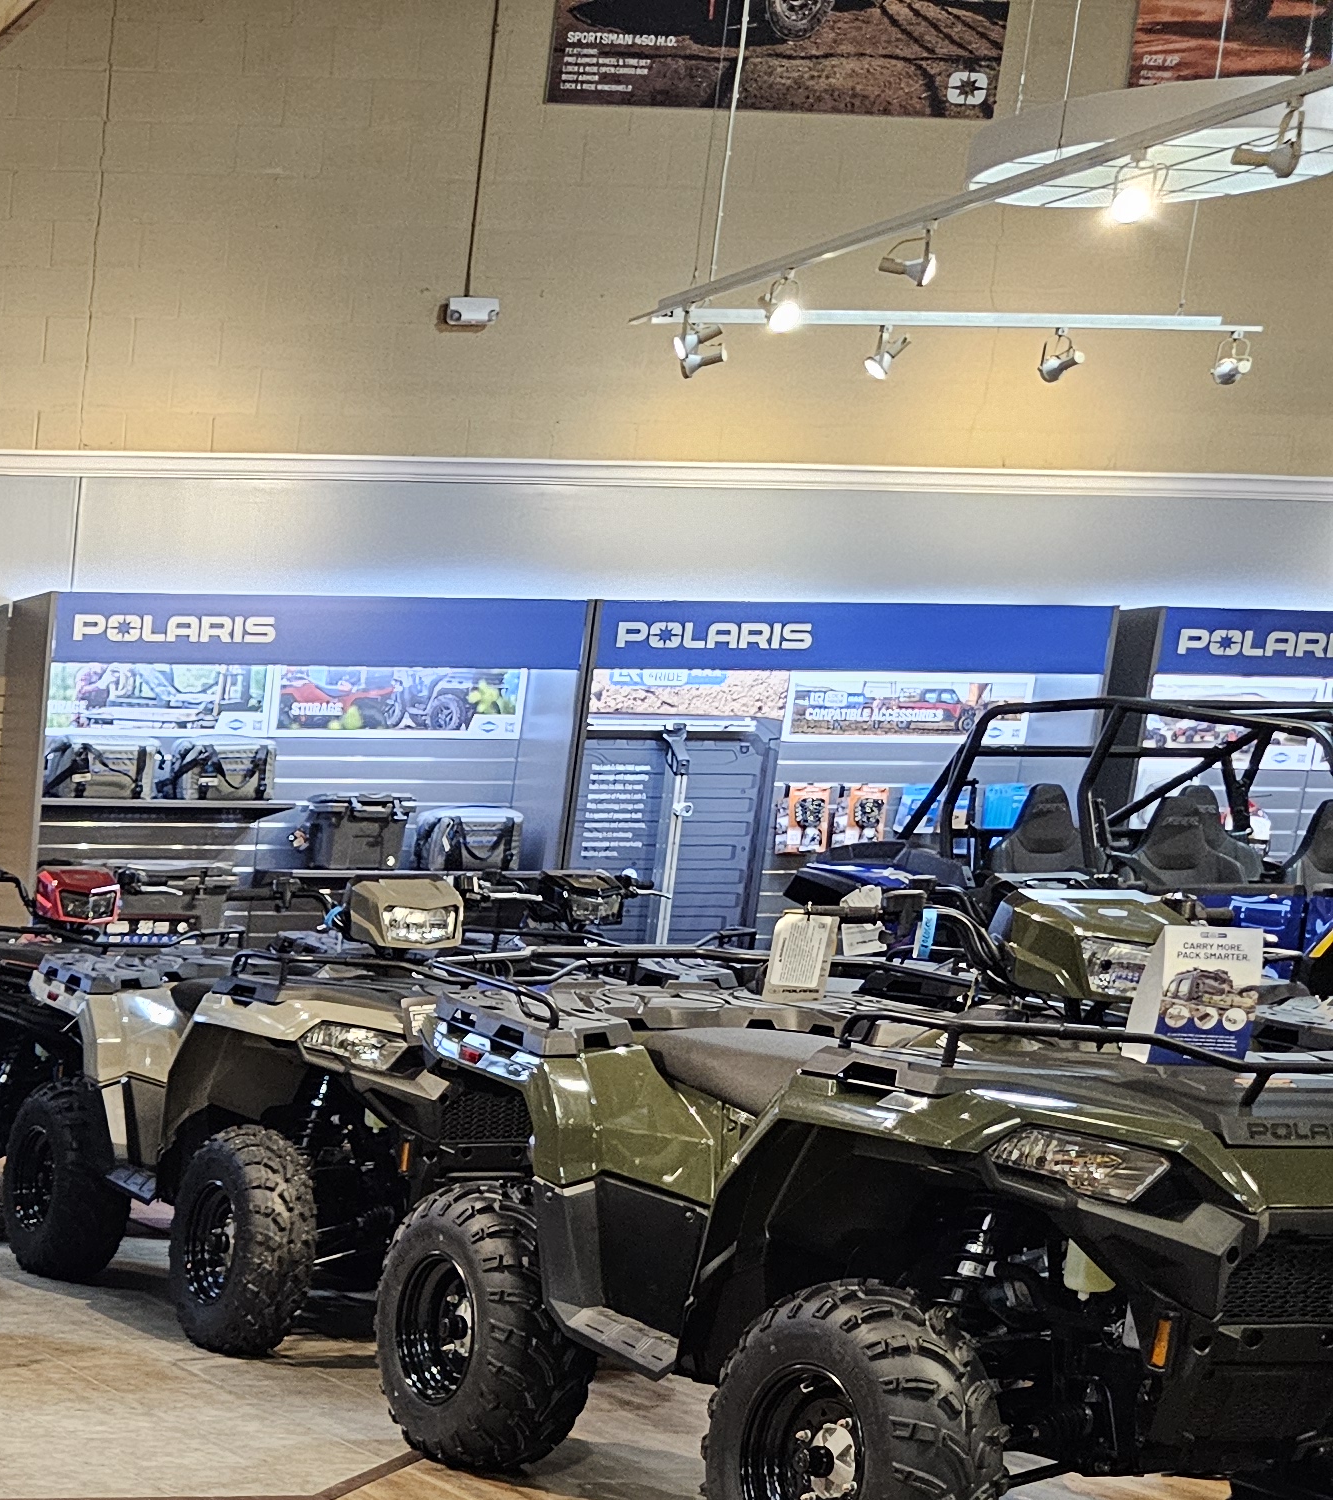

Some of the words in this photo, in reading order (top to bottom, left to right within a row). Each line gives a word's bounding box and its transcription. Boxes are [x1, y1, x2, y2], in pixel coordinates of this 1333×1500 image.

[567, 31, 633, 45] SPORTSMAN
[634, 34, 655, 46] 450
[73, 613, 276, 644] POLARIS
[615, 621, 813, 650] POLARIS
[291, 702, 344, 716] STORAGE
[805, 708, 870, 721] COMPATIBLE
[871, 708, 944, 722] ACCESSORIES
[1183, 942, 1215, 951] CARRY
[1216, 943, 1245, 952] MORE.
[1176, 951, 1202, 960] PACK
[1203, 951, 1250, 962] SMARTER.
